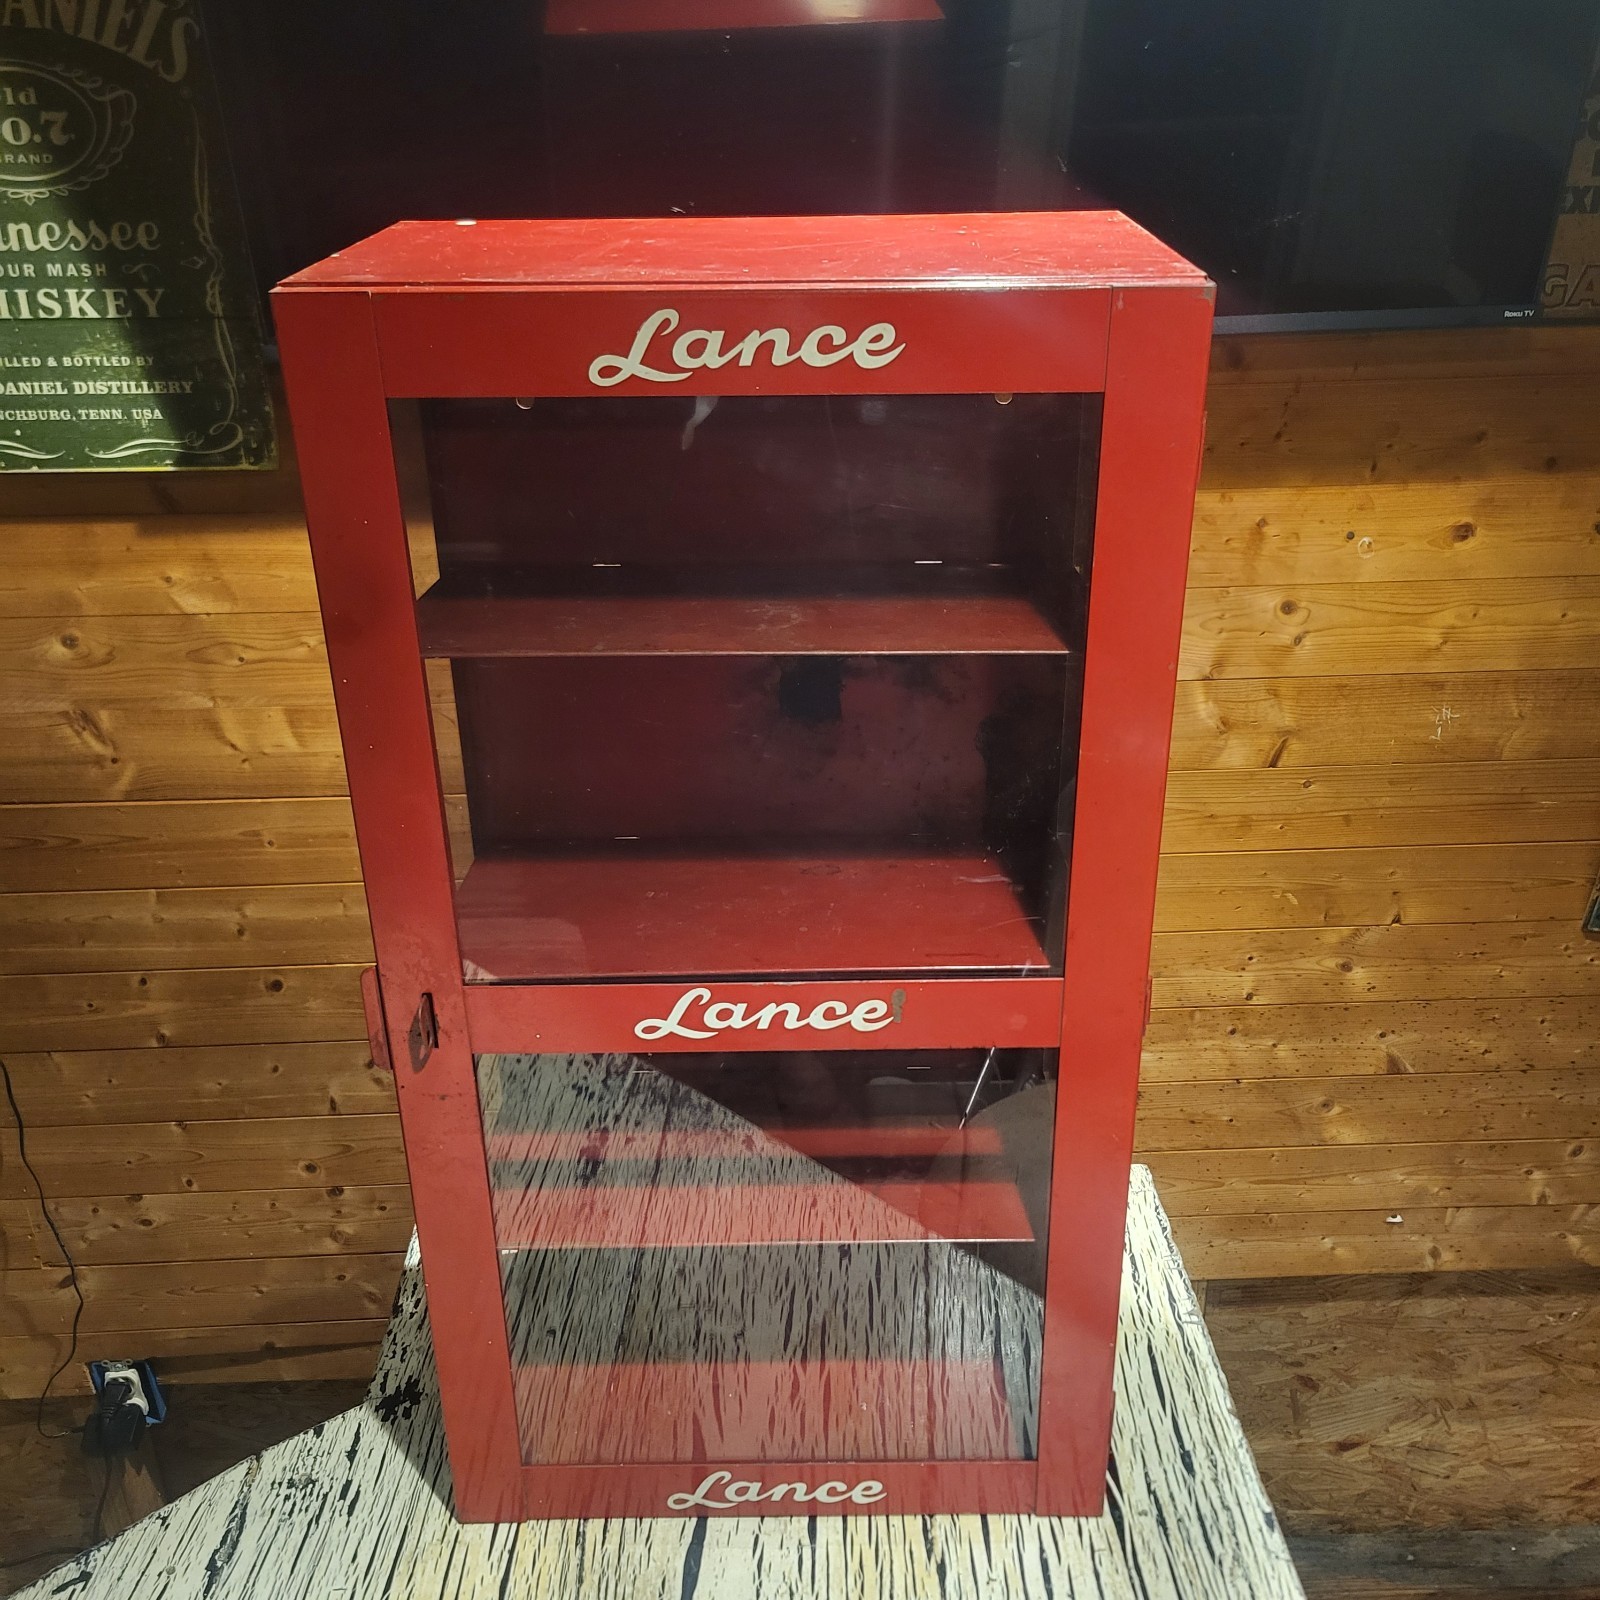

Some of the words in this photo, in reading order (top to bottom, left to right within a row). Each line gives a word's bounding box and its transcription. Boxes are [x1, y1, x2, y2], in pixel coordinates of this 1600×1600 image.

[0, 86, 38, 105] ld
[0, 153, 53, 164] RAND
[46, 263, 108, 278] MASH
[1524, 309, 1535, 317] TV
[588, 308, 906, 387] Lance
[47, 356, 59, 367] &
[62, 356, 131, 367] BOTTLED
[136, 356, 154, 367] BY
[73, 381, 194, 395] DISTILLERY
[132, 408, 164, 421] USA
[633, 987, 895, 1040] Lance
[666, 1470, 888, 1510] Lance
